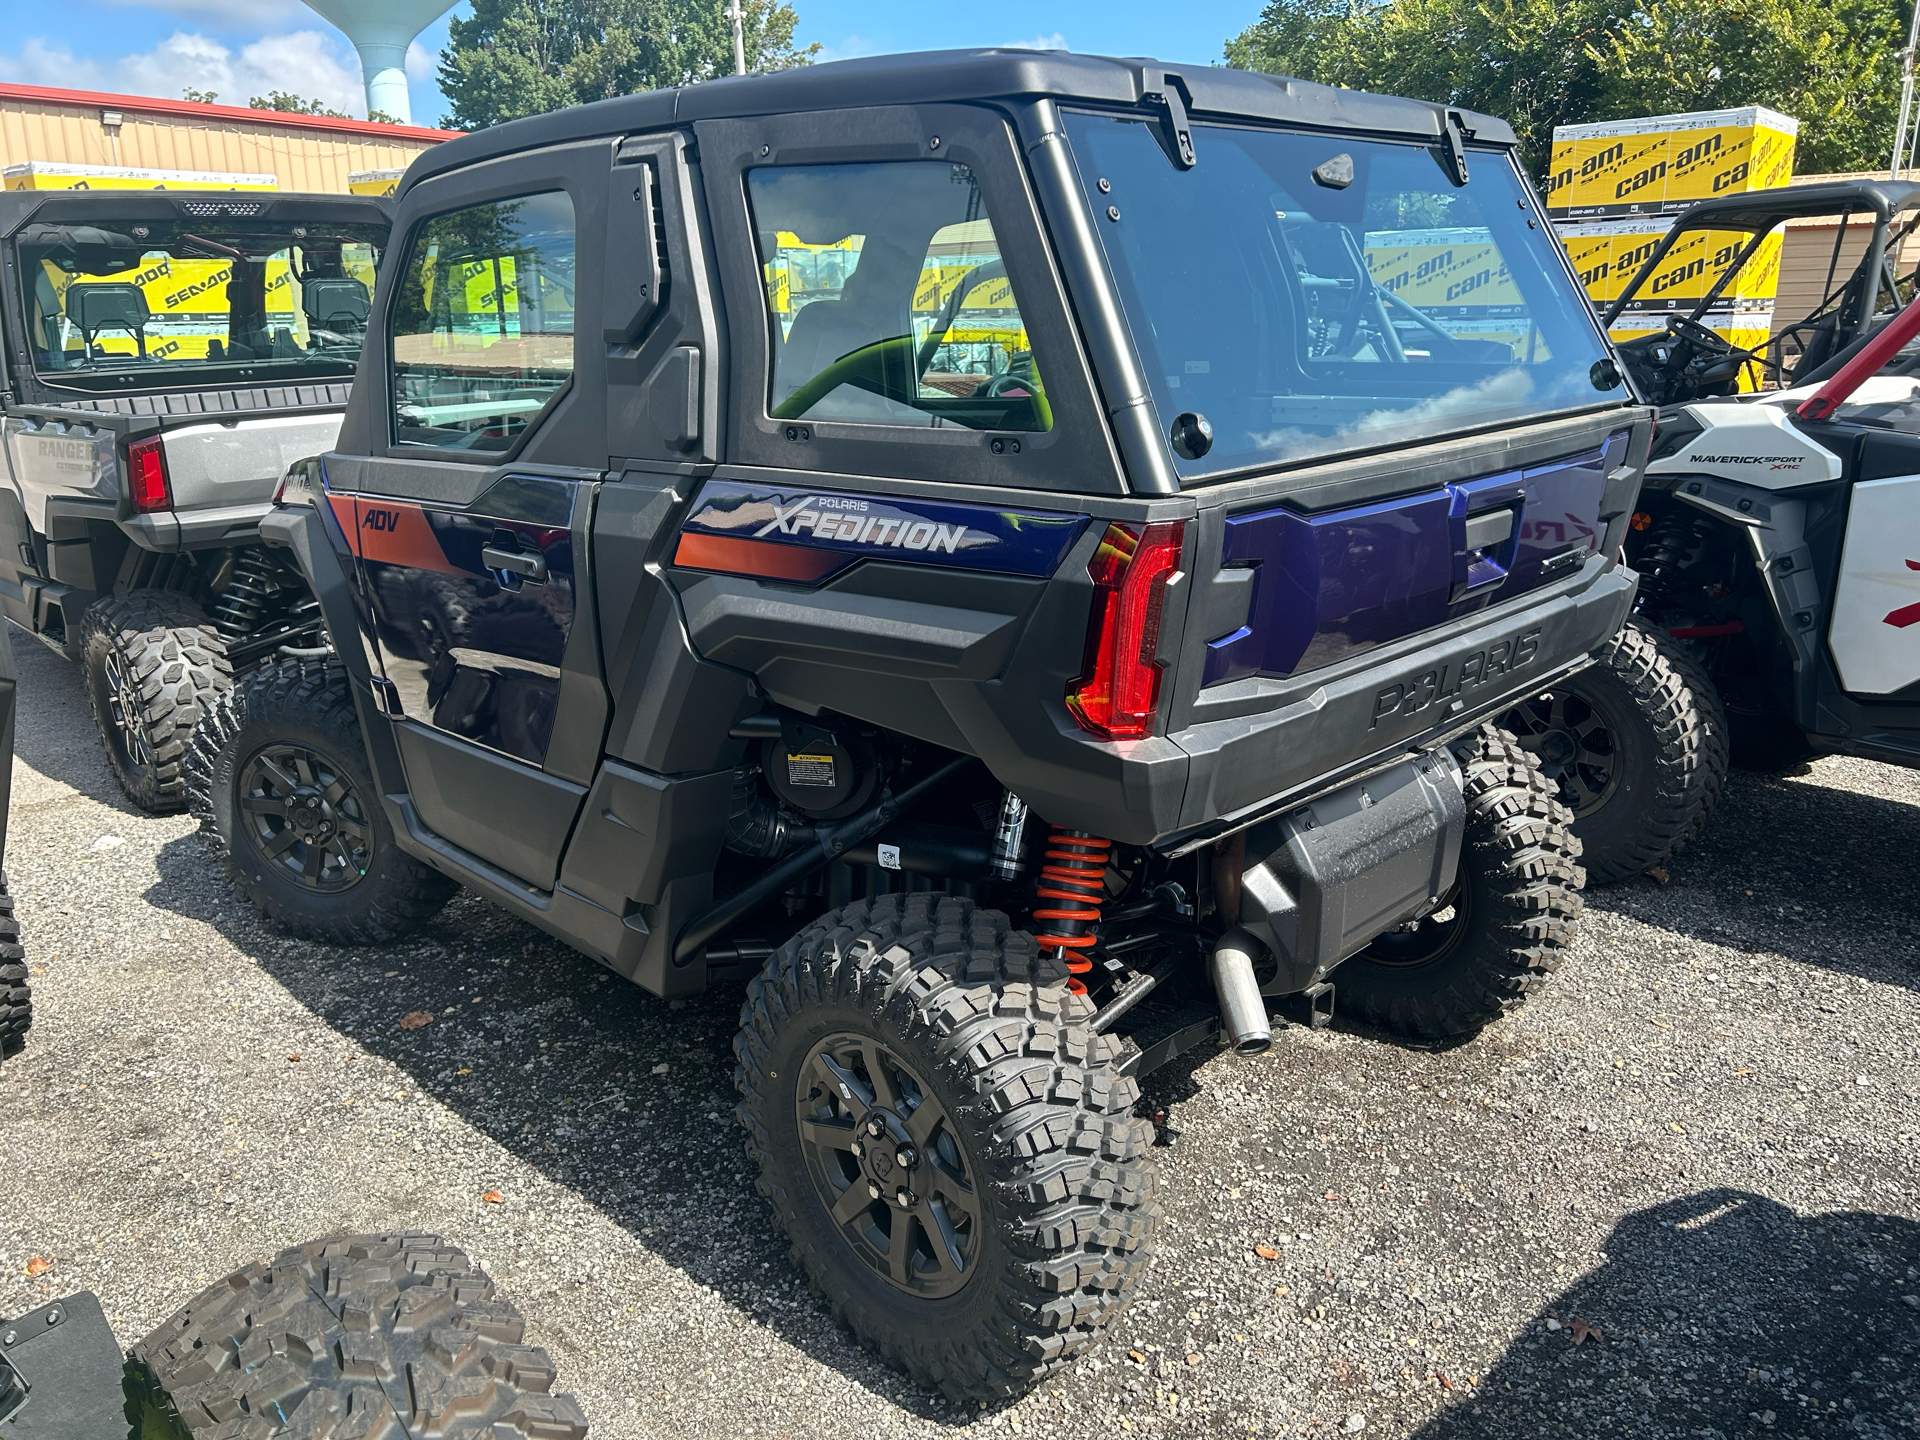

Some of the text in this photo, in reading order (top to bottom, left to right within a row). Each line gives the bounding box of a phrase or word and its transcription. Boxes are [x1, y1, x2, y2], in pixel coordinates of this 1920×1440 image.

[1548, 143, 1623, 193] an-am
[1616, 133, 1722, 199] can-am
[1382, 250, 1453, 292] an-am
[1446, 263, 1512, 301] can-a
[1579, 239, 1661, 287] an-am
[38, 440, 96, 460] RANGER
[1769, 463, 1801, 471] XRC
[362, 508, 400, 533] ADV
[752, 495, 968, 555] XPEDITION
[818, 497, 868, 512] POLARIS
[1367, 626, 1542, 732] POLARIS
